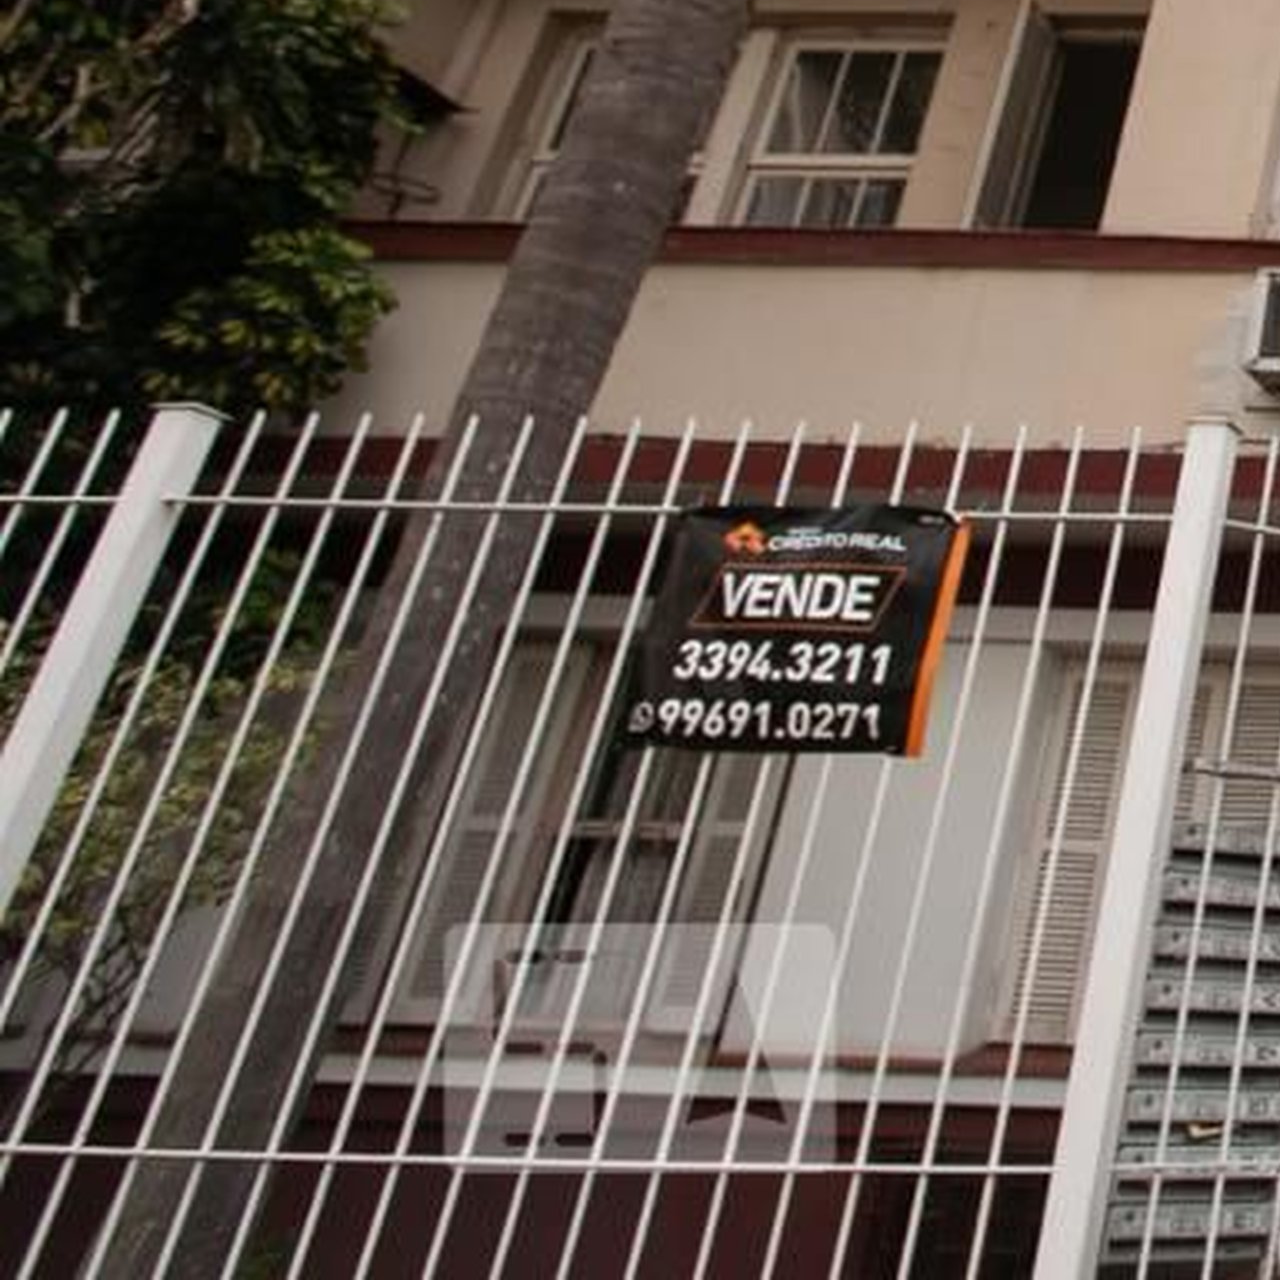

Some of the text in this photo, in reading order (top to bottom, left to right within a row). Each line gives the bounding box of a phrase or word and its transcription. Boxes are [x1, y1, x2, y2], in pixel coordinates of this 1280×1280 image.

[849, 532, 907, 552] REAL
[723, 574, 880, 620] VENDE
[673, 640, 892, 684] 3394.3211
[657, 699, 881, 739] 99691.0271
